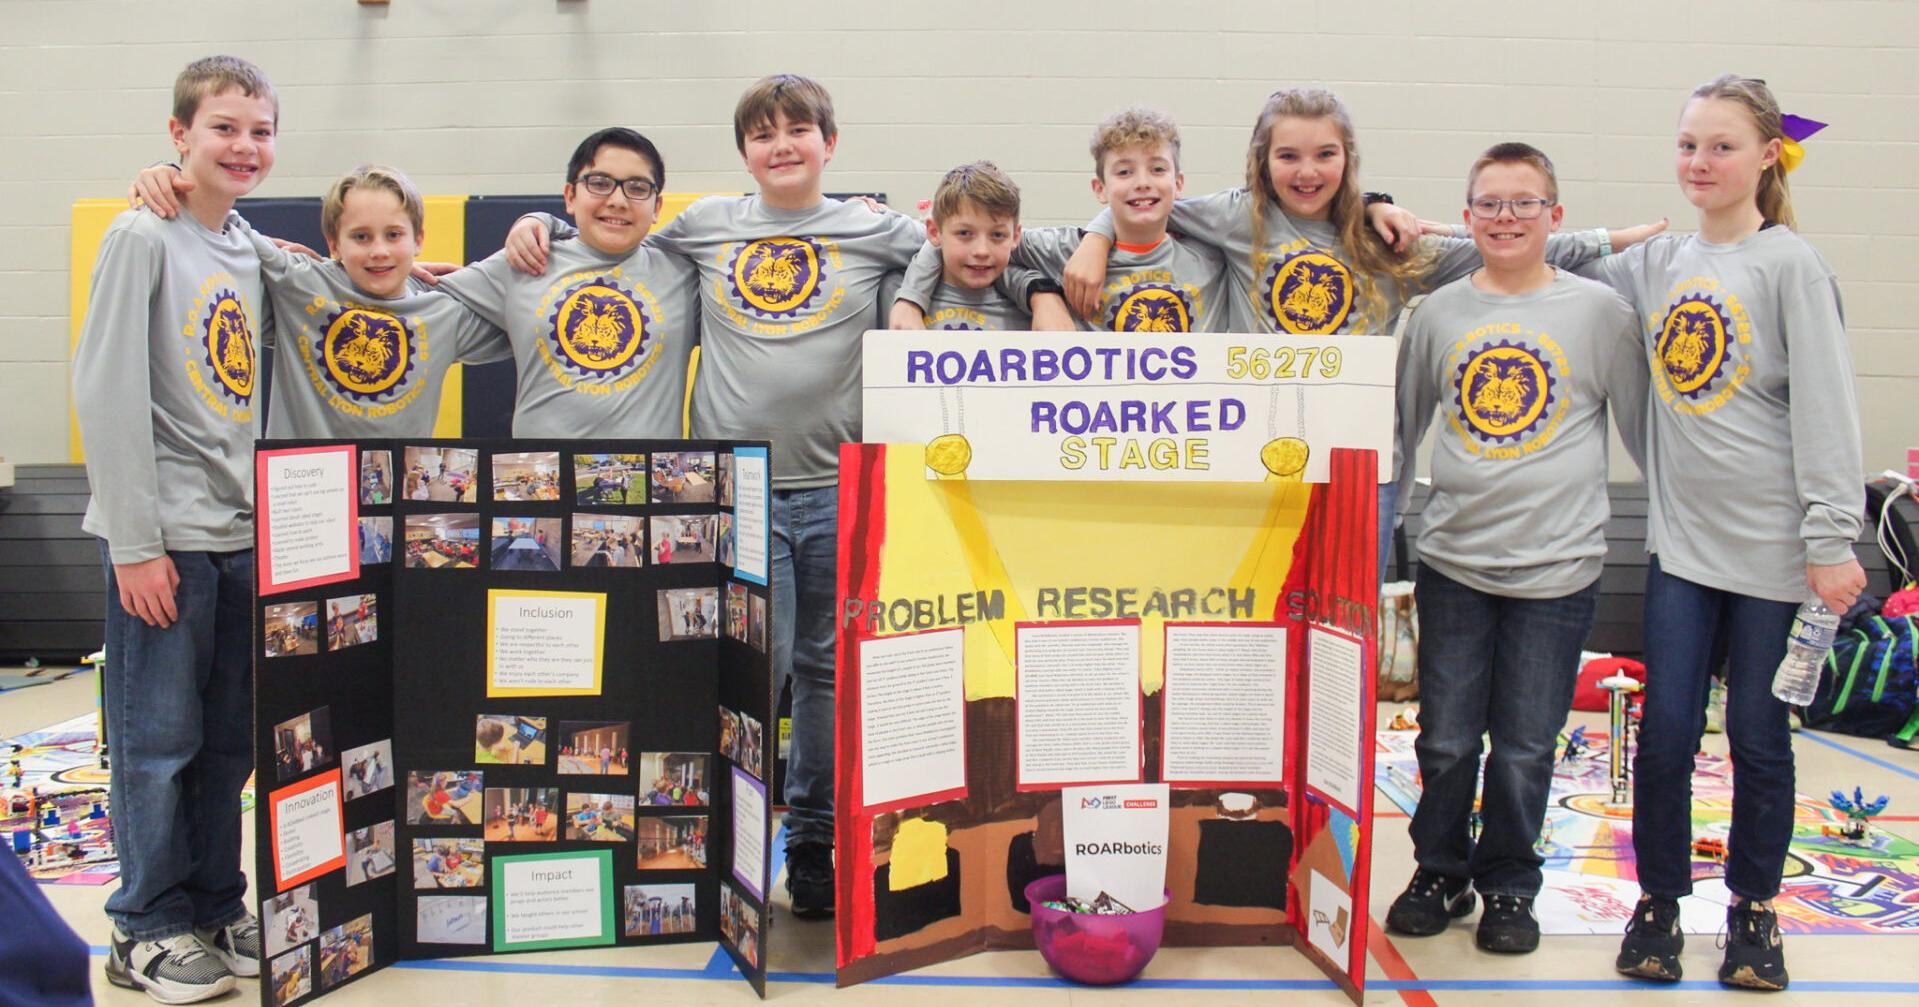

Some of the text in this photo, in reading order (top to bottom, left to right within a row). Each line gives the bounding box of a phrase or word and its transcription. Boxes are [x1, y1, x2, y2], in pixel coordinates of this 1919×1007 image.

[750, 321, 788, 335] LYON
[923, 307, 987, 327] RBOTICS
[575, 381, 612, 396] LYON
[614, 342, 664, 392] ROBOTICS
[907, 345, 1343, 385] ROARBOTICS 56279
[327, 394, 364, 417] LYON
[367, 377, 426, 418] ROBOTICS
[1031, 398, 1247, 434] ROARKED
[1059, 435, 1211, 471] STAGE
[1484, 446, 1521, 460] LYON
[284, 468, 324, 480] Discovery
[519, 607, 574, 619] Inclusion
[842, 586, 1374, 640] PROBLEM RESEARCH SOLUTION
[285, 788, 335, 814] Innovation
[1075, 841, 1162, 856] ROARbotics
[531, 870, 573, 883] Impact
